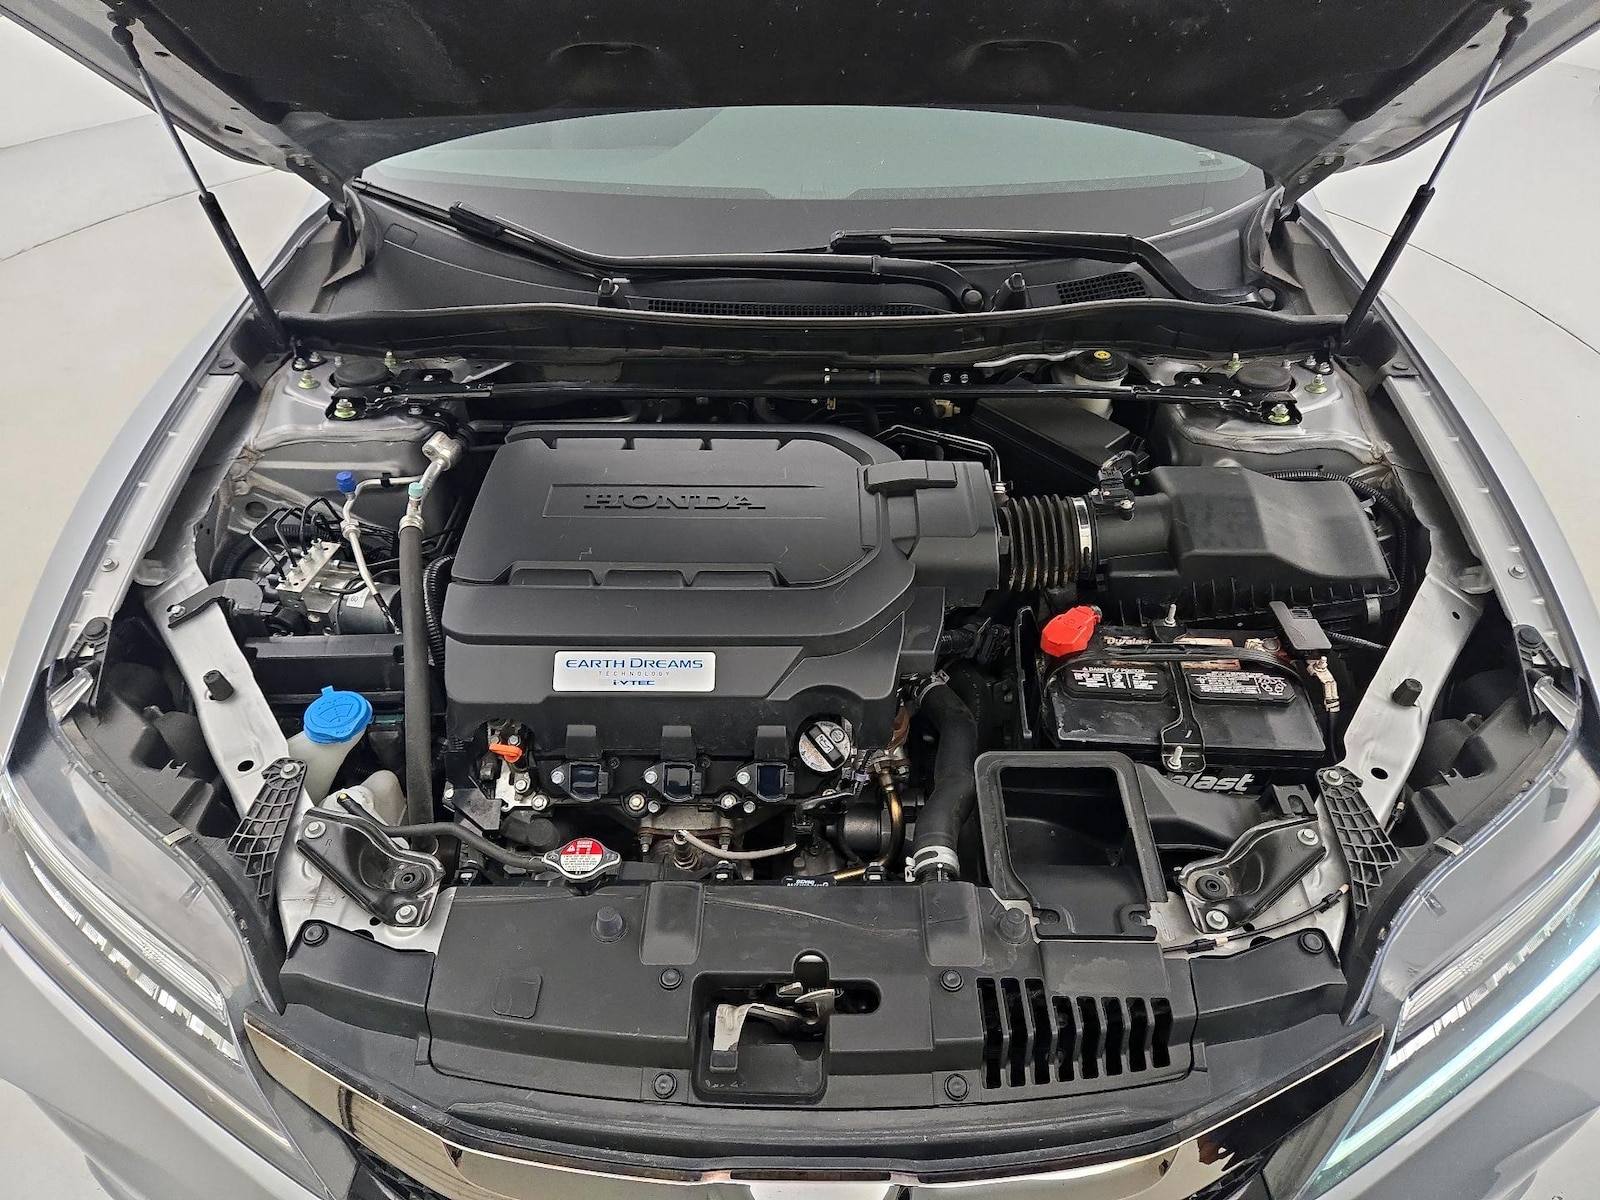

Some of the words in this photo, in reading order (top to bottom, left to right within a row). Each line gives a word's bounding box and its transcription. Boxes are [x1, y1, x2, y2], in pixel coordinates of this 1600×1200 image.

[583, 494, 766, 509] HONDA
[565, 659, 625, 669] EARTH
[630, 658, 703, 669] DREAMS
